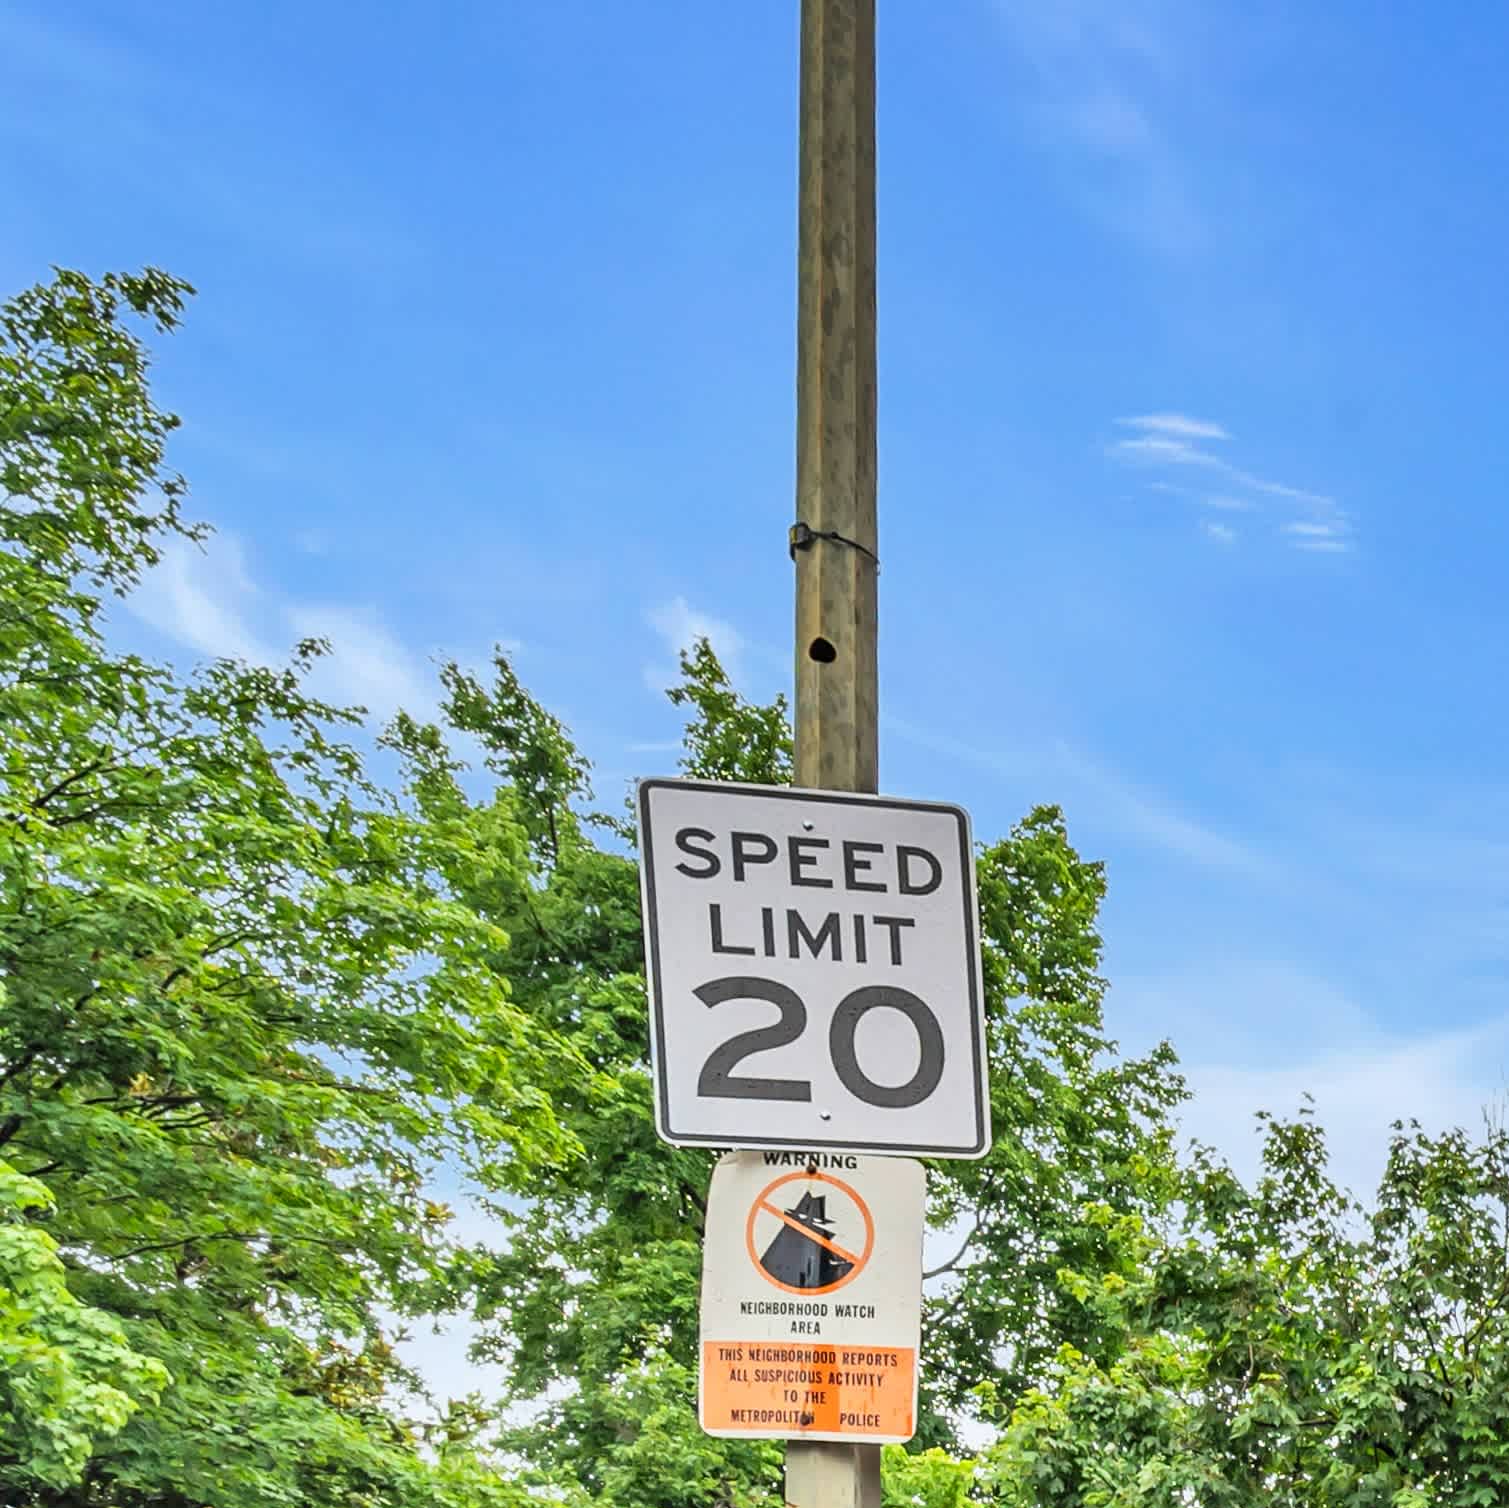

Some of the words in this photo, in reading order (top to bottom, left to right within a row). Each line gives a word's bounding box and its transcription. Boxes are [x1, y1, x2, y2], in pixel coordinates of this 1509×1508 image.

[674, 826, 944, 896] SPEED
[708, 903, 916, 967] LIMIT
[691, 975, 946, 1110] 20
[763, 1151, 858, 1170] WARNING
[740, 1301, 828, 1317] NEIGHBORHOOD
[835, 1304, 876, 1319] WATCH
[790, 1321, 821, 1335] AREA
[719, 1347, 744, 1362] THIS
[749, 1348, 836, 1365] NEIGHBORHOOD
[842, 1352, 898, 1368] REPORTS
[729, 1368, 749, 1383] ALL
[754, 1368, 822, 1384] SUSPICIOUS
[828, 1371, 884, 1387] ACTIVITY
[783, 1389, 799, 1403] TO
[805, 1390, 827, 1405] THE
[840, 1412, 881, 1428] POLICE
